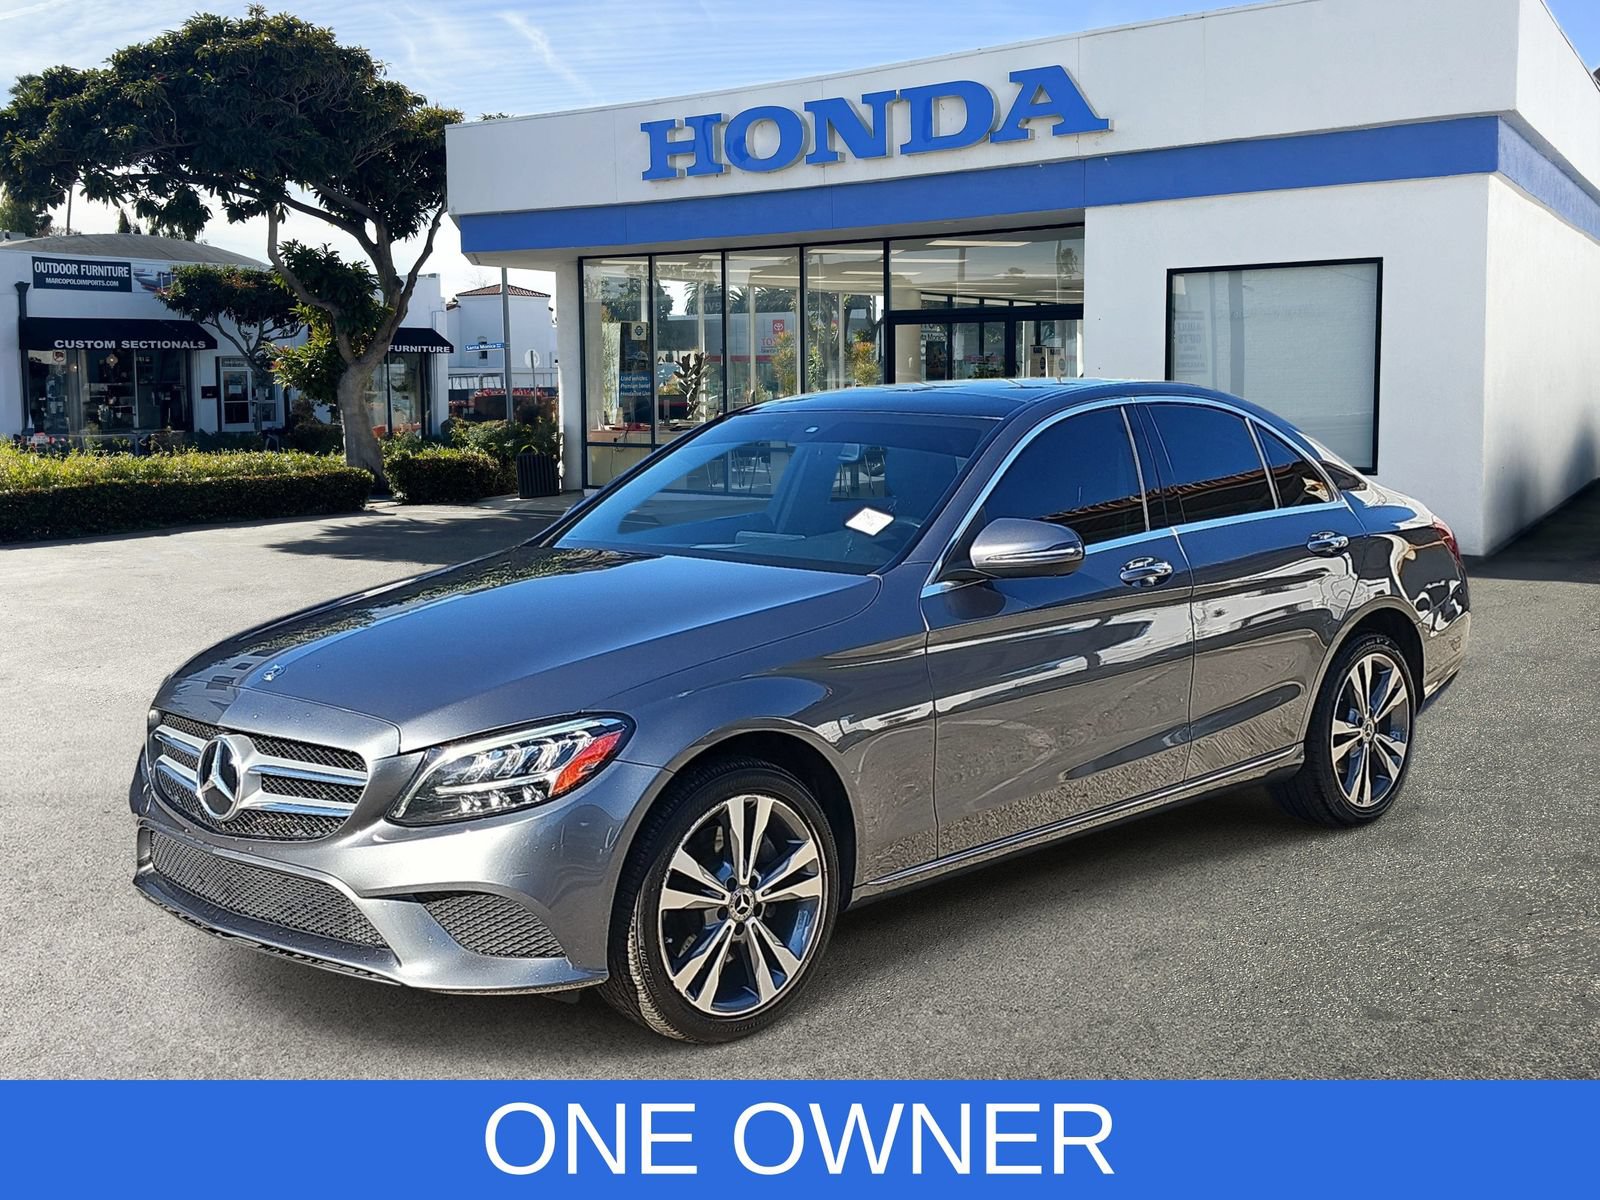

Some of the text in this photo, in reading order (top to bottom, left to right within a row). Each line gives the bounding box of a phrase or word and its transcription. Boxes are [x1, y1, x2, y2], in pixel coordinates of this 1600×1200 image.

[640, 64, 1111, 182] HONDA
[34, 261, 130, 278] OUTDOOR FURNITURE
[45, 277, 119, 287] MARCOPOLOIMPORTS.COM
[54, 339, 206, 349] CUSTOM SECTIONALS
[388, 344, 451, 353] FURNITURE
